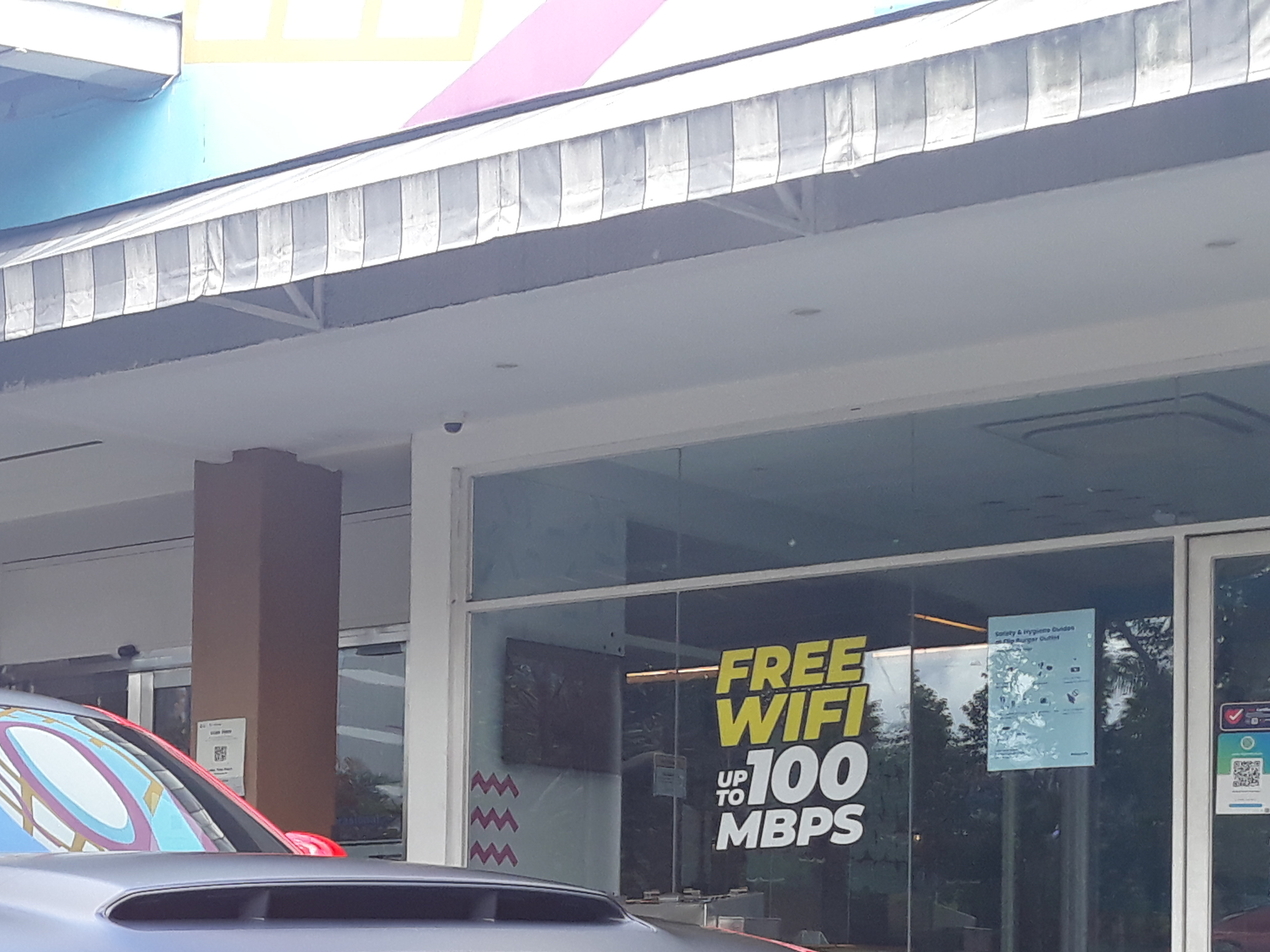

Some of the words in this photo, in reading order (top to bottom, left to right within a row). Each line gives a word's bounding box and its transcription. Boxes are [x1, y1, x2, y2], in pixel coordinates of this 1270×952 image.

[716, 636, 867, 694] FREE
[716, 686, 868, 747] WIFI
[716, 788, 745, 807] TO
[717, 770, 748, 788] UP
[746, 741, 869, 805] 100
[716, 803, 866, 850] MBPS
